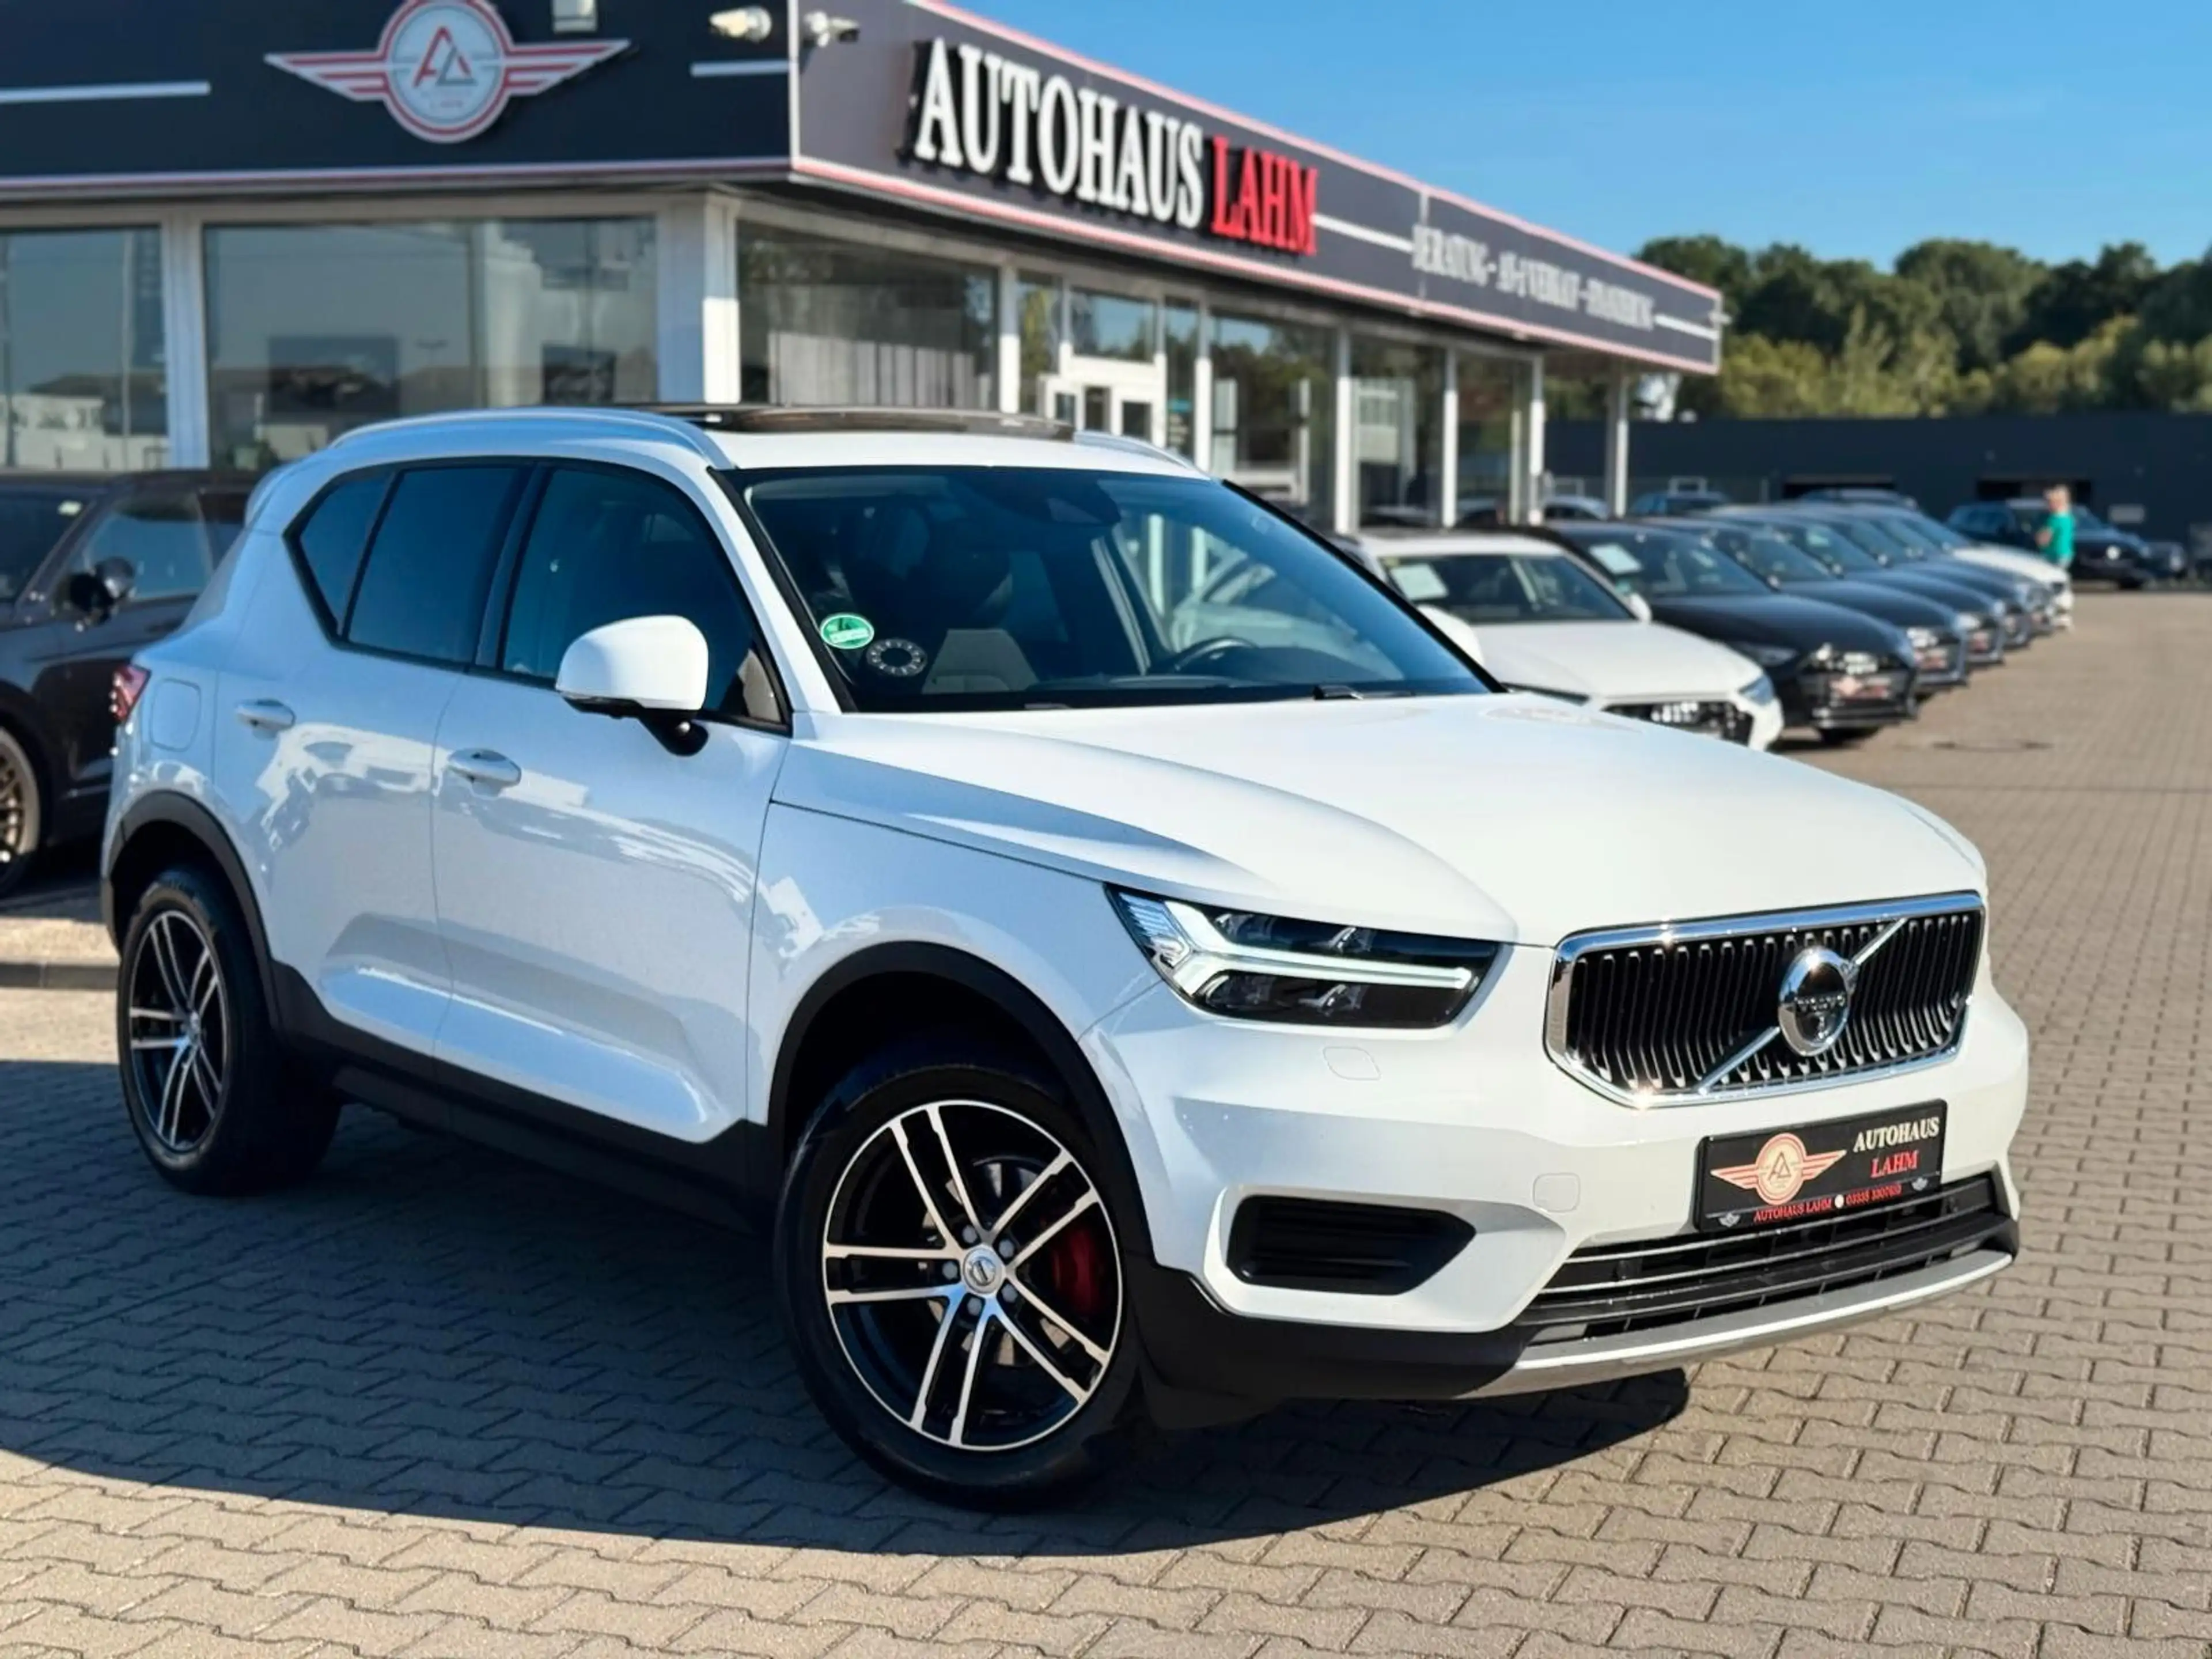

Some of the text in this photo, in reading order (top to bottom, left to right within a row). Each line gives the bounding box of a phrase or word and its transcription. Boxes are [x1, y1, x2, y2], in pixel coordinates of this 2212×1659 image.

[915, 37, 1317, 256] AUTOHAUS LAHM
[1854, 1117, 1940, 1153] AUTOHAUS
[1871, 1150, 1918, 1178] LAHM
[1754, 1203, 1804, 1222] AUTOHAUS
[1805, 1198, 1832, 1214] LAHM
